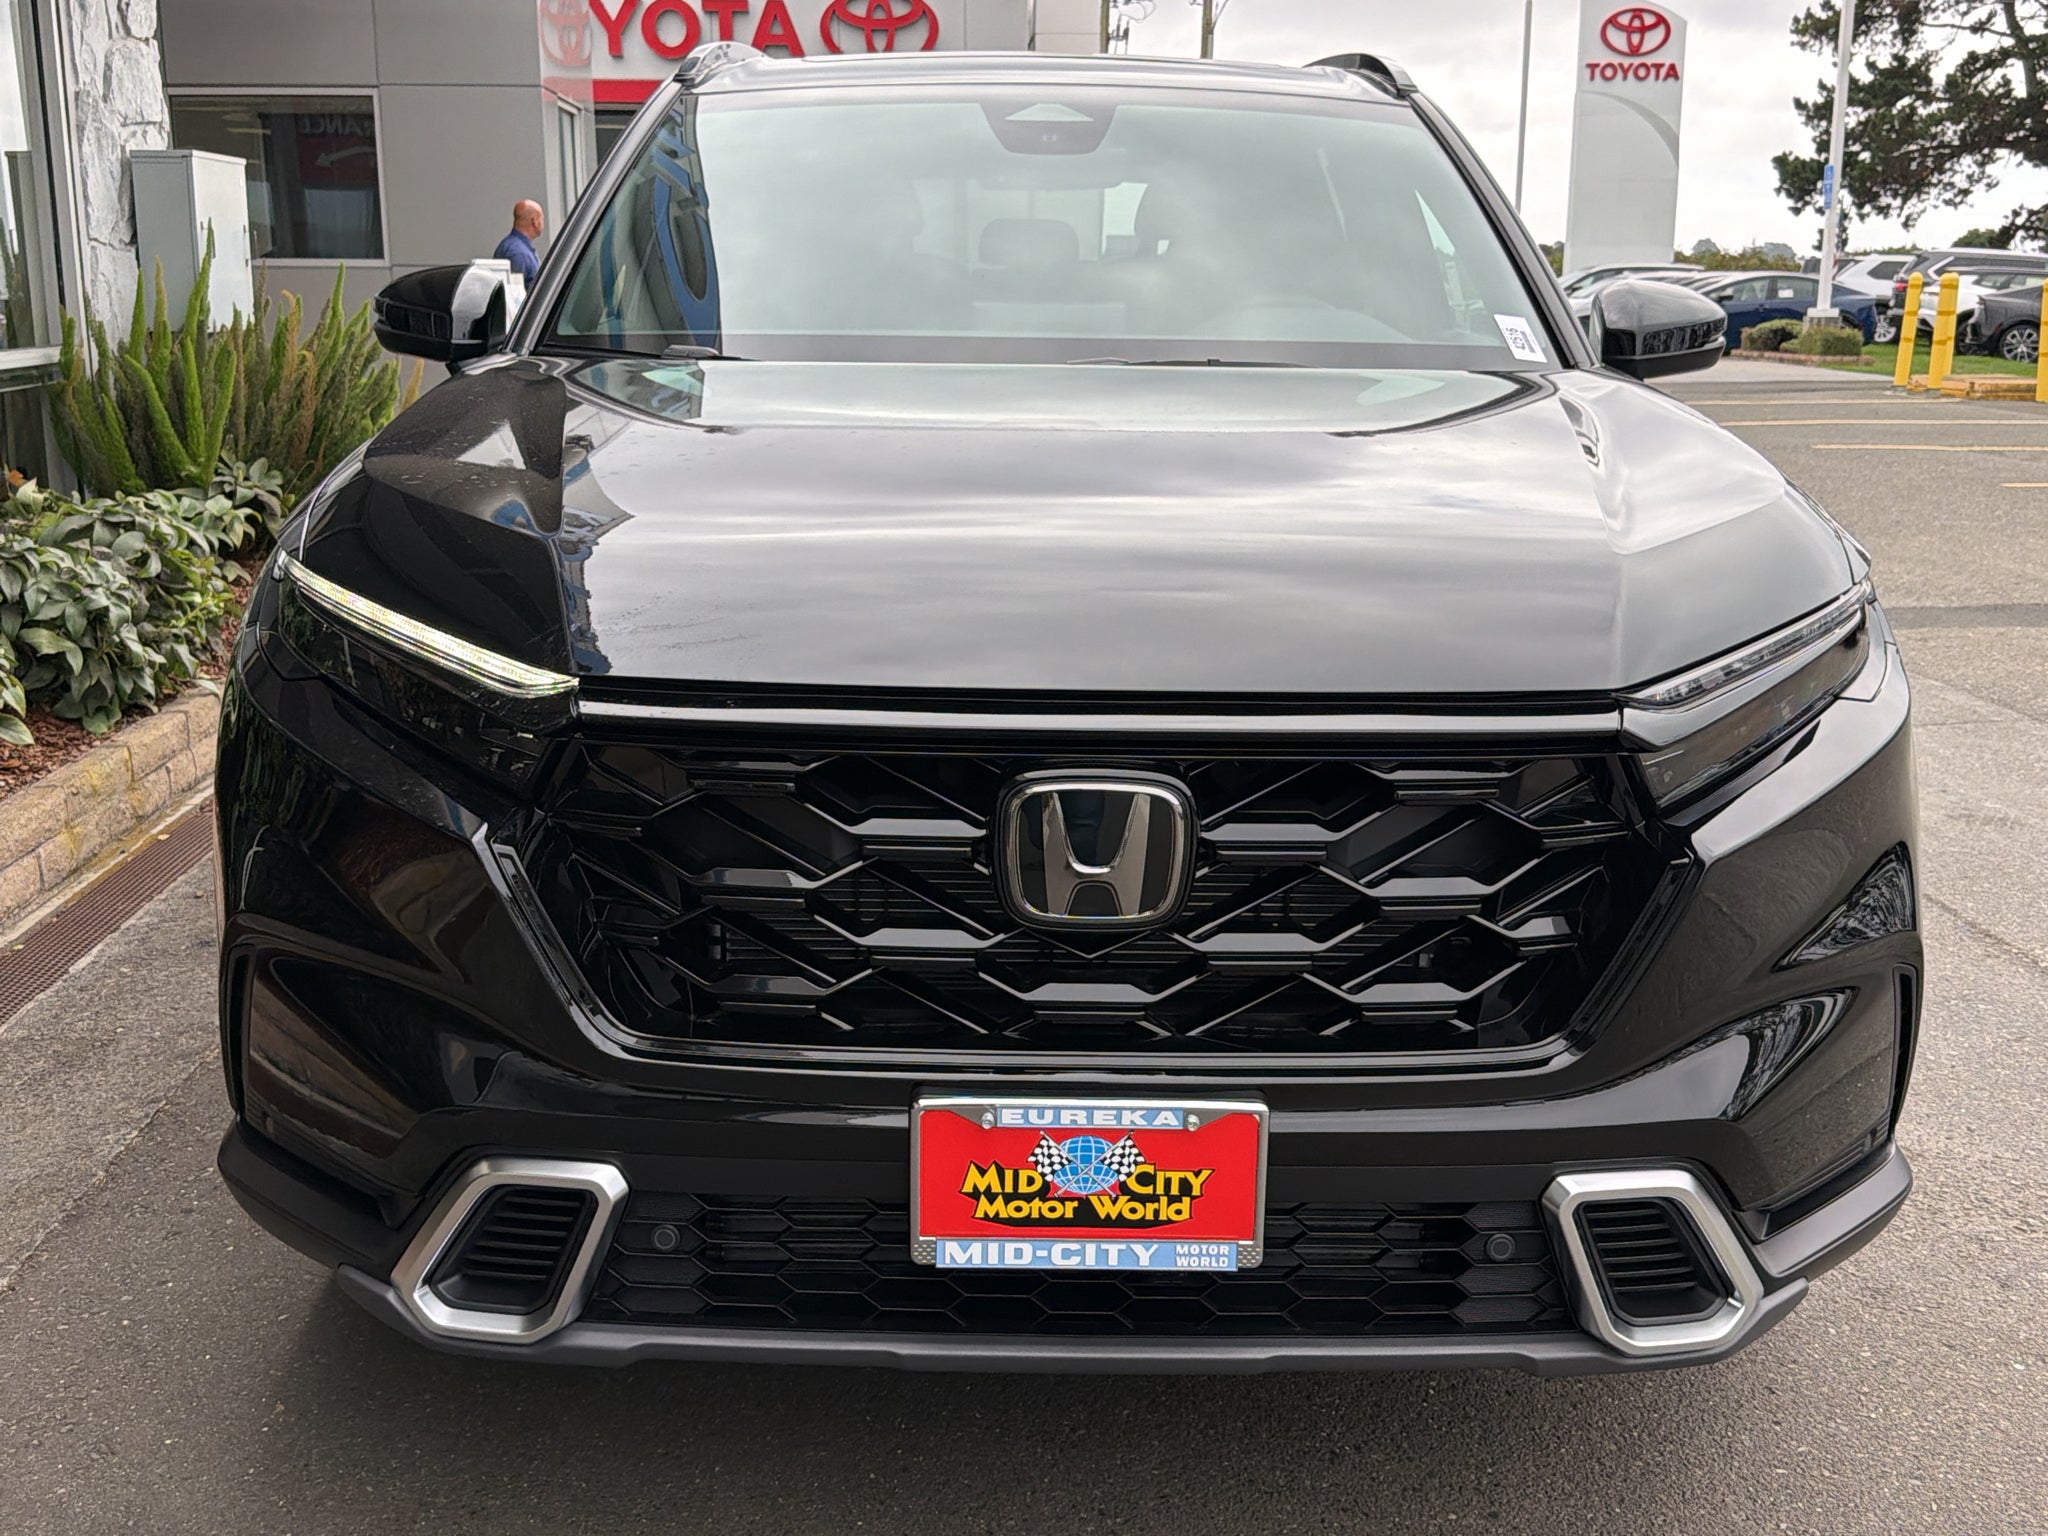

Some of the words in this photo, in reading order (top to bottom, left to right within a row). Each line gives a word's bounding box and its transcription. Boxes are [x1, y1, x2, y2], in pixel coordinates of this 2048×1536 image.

[1585, 62, 1679, 82] TOYOTA
[1001, 1109, 1180, 1126] EUREKA
[961, 1161, 1044, 1194] MID
[1126, 1164, 1215, 1196] CITY
[974, 1196, 1078, 1219] Motor
[1089, 1196, 1192, 1221] World
[944, 1242, 1160, 1266] MID-CITY
[1176, 1245, 1230, 1255] MOTOR
[1176, 1256, 1229, 1268] WORLD
